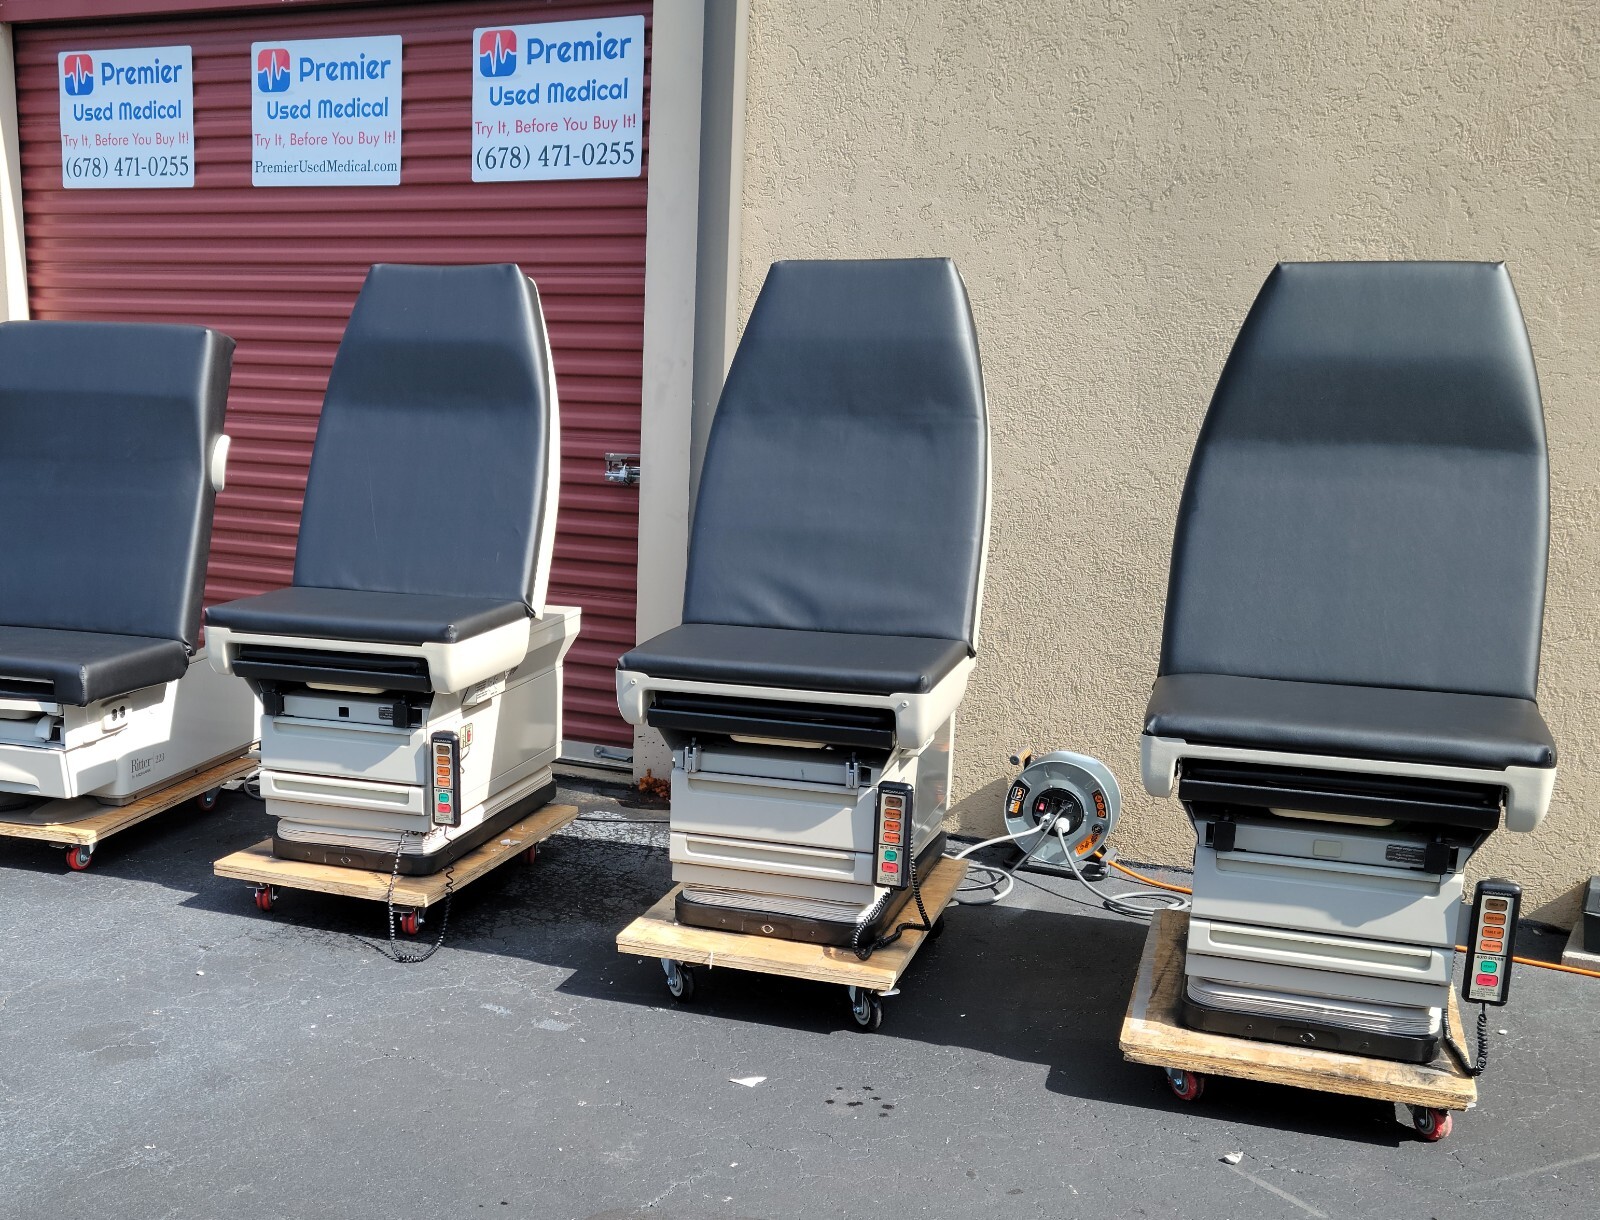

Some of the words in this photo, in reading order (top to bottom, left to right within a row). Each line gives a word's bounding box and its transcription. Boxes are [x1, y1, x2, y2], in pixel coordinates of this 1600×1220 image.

[526, 31, 632, 65] Premier
[101, 58, 183, 86] Premier
[299, 52, 392, 82] Premier
[489, 83, 540, 106] Used
[547, 77, 629, 104] Medical
[73, 102, 113, 121] Used
[118, 99, 182, 120] Medical
[266, 99, 311, 120] Used
[317, 96, 389, 119] Medical
[474, 121, 493, 139] Try
[497, 120, 510, 137] It,
[514, 117, 559, 134] Before
[562, 116, 588, 132] You
[592, 115, 618, 132] Buy
[622, 113, 637, 129] It!
[63, 134, 79, 150] Try
[81, 133, 92, 149] It,
[94, 132, 129, 147] Before
[131, 132, 152, 145] You
[155, 132, 175, 148] Buy
[178, 131, 189, 145] It!
[254, 133, 271, 150] Try
[274, 133, 286, 148] It,
[289, 131, 328, 146] Before
[331, 131, 354, 145] You
[357, 131, 380, 148] Buy
[383, 130, 396, 144] It!
[65, 156, 109, 179] (678)
[114, 155, 190, 177] 471-0255
[254, 159, 398, 173] PremierUsedMedical.com
[476, 144, 531, 171] (678)
[537, 140, 636, 168] 471-0255
[130, 758, 153, 773] Ritter
